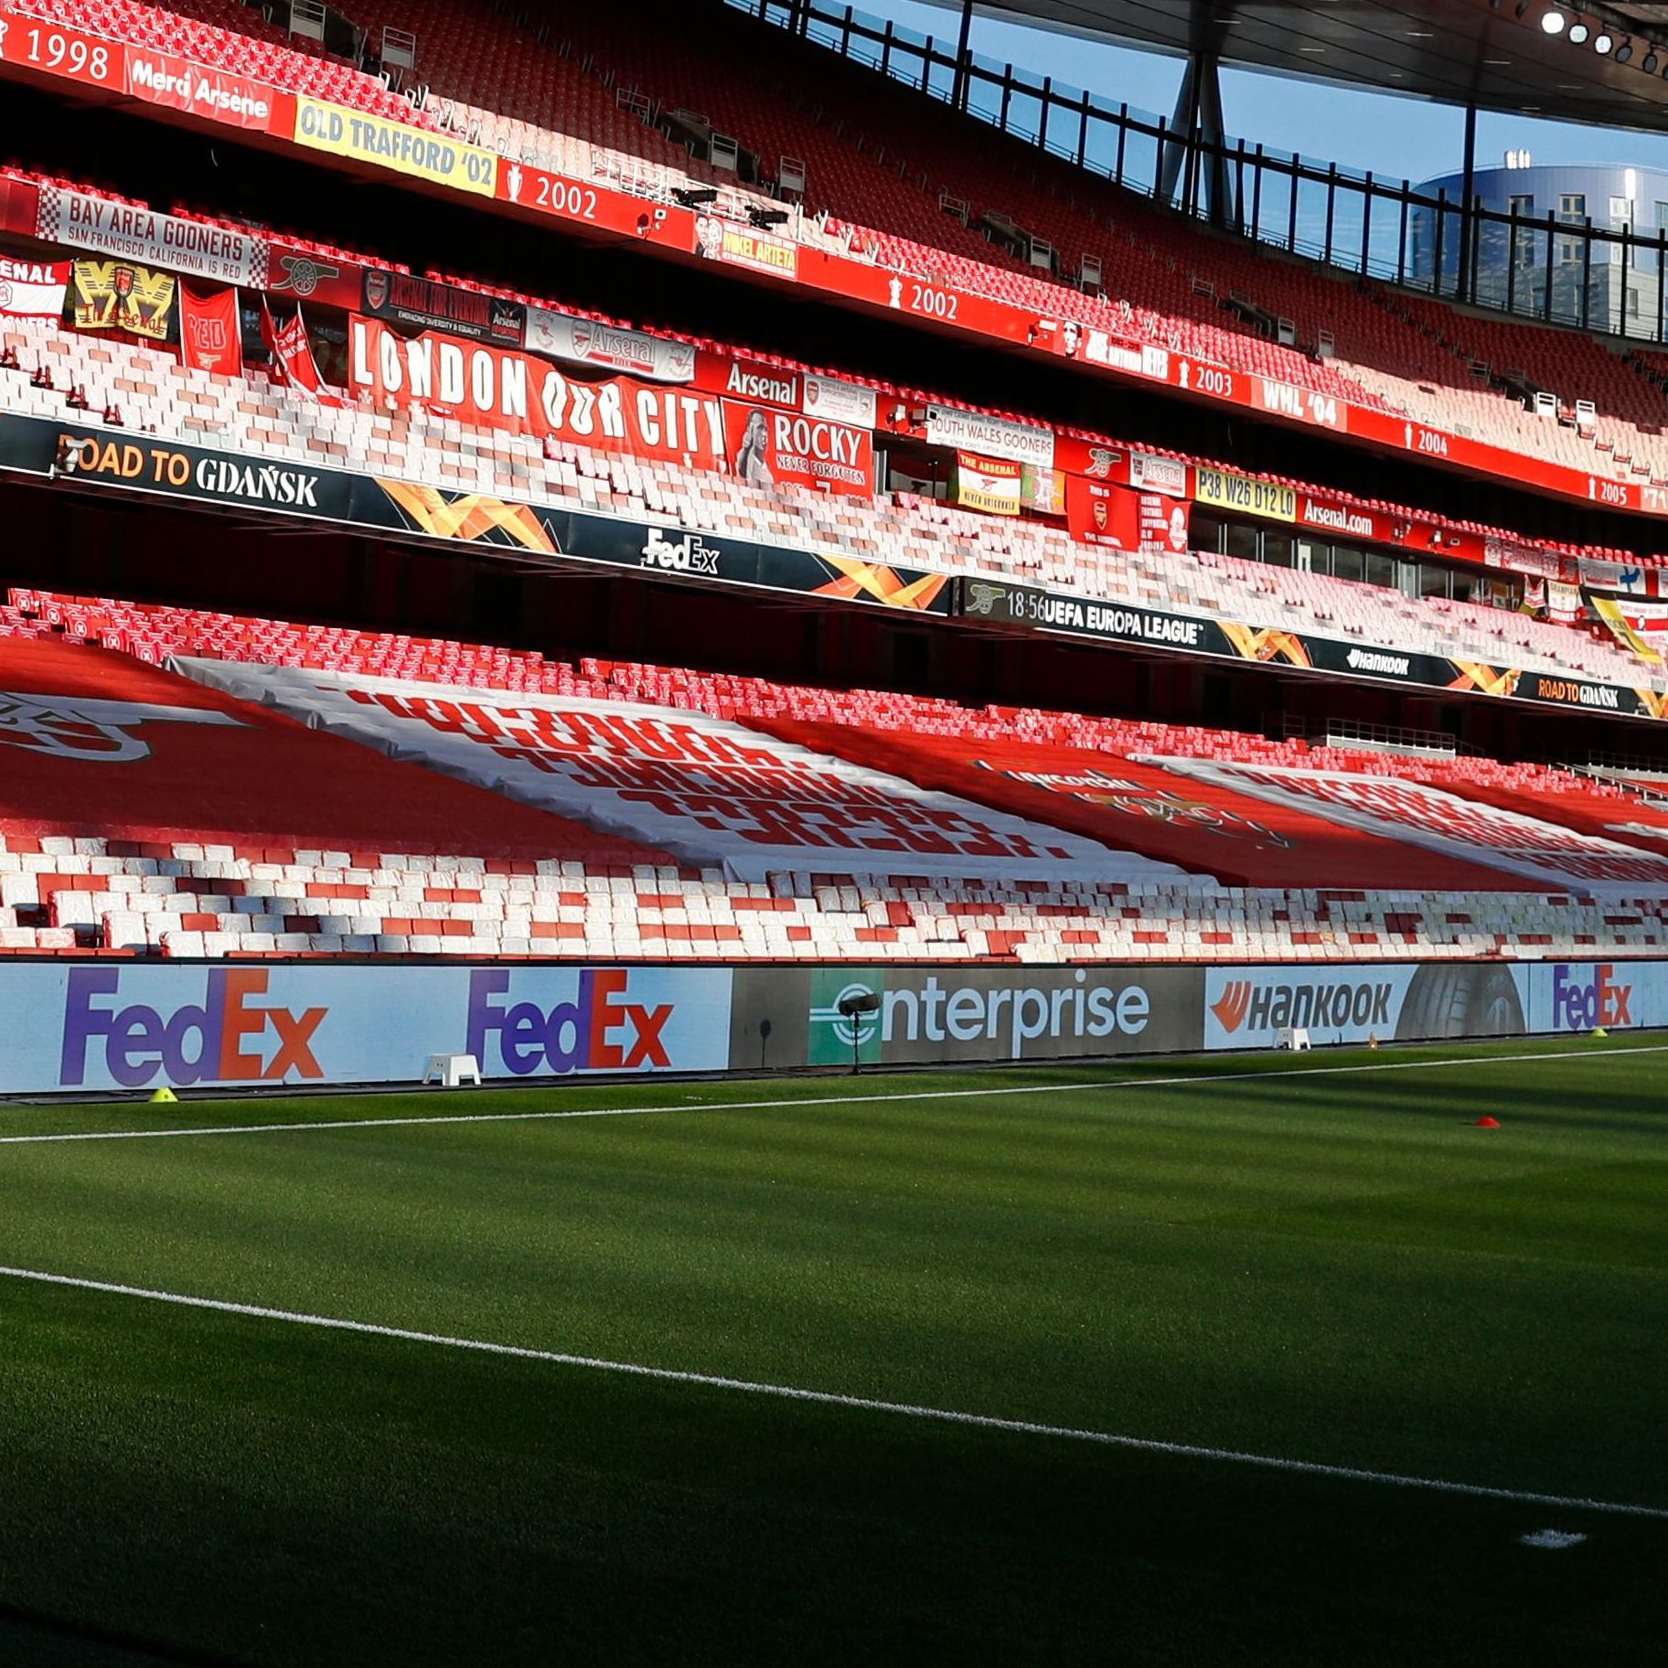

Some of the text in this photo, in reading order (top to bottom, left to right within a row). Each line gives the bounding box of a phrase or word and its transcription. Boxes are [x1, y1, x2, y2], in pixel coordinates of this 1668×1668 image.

[27, 28, 109, 80] 1998
[132, 58, 191, 98] Merci
[301, 104, 343, 142] OLD
[350, 117, 456, 175] TRAFFORD
[535, 176, 598, 220] 2002
[69, 197, 243, 261] BAY AREA GOONERS
[723, 231, 755, 259] MIKEL
[68, 226, 241, 279] SAN FRANCISCO CALIFORNIA IS RED
[911, 284, 958, 320] 2002
[592, 325, 656, 363] Arsenal
[353, 322, 527, 419] LONDON
[540, 371, 625, 438] OUR
[636, 389, 726, 456] CITY
[726, 362, 797, 406] Arsenal
[1196, 366, 1232, 397] 2003
[1262, 378, 1304, 418] WHL
[774, 415, 862, 467] ROCKY
[967, 423, 1002, 444] WALES
[1003, 432, 1052, 456] GOONERS
[1417, 429, 1448, 456] 2004
[150, 439, 321, 508] TO GDAŃSK
[960, 455, 1016, 476] THE ARSENAL
[1198, 469, 1276, 514] P38 W26 D12
[1600, 481, 1628, 506] 2005
[1304, 499, 1373, 537] Arsenal.com
[643, 528, 719, 575] FedEx
[1006, 592, 1045, 621] 18:56
[1044, 597, 1198, 645] UEFA EUROPA LEAGUE
[1538, 679, 1619, 708] ROAD TO GDAŃSK
[1553, 963, 1632, 1030] FedEx
[60, 966, 328, 1087] FedEx
[464, 968, 674, 1075] FedEx
